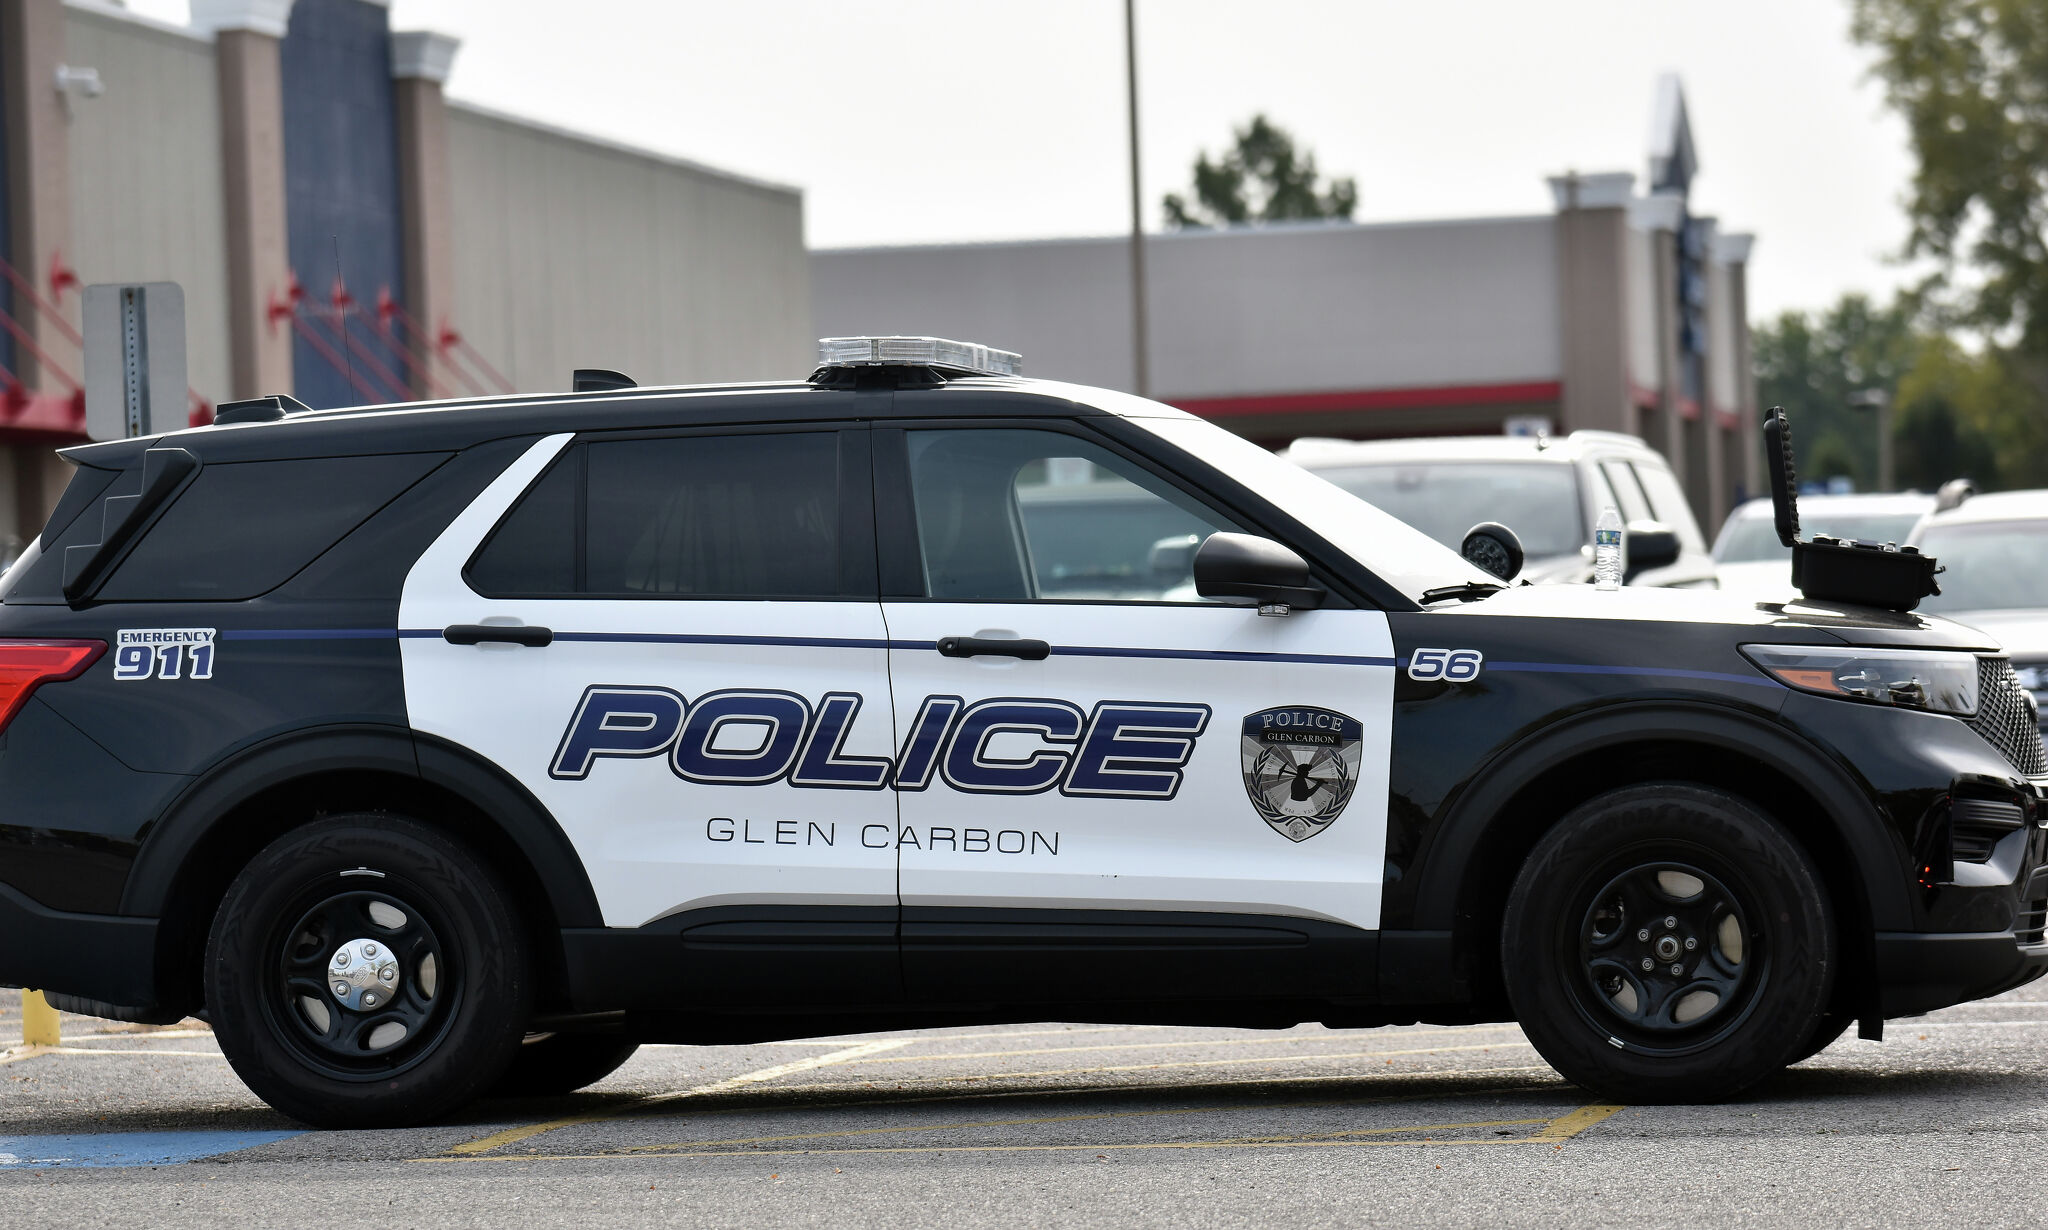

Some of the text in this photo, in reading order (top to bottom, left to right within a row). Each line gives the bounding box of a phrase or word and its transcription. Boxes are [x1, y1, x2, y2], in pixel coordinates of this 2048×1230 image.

[120, 631, 212, 643] EMERGENCY
[115, 645, 214, 680] 911
[1408, 648, 1483, 682] 56
[1262, 712, 1344, 732] POLICE
[1267, 732, 1335, 744] GLEN CARBON
[548, 684, 1211, 801] POLICE
[706, 817, 1060, 856] GLEN CARBON
